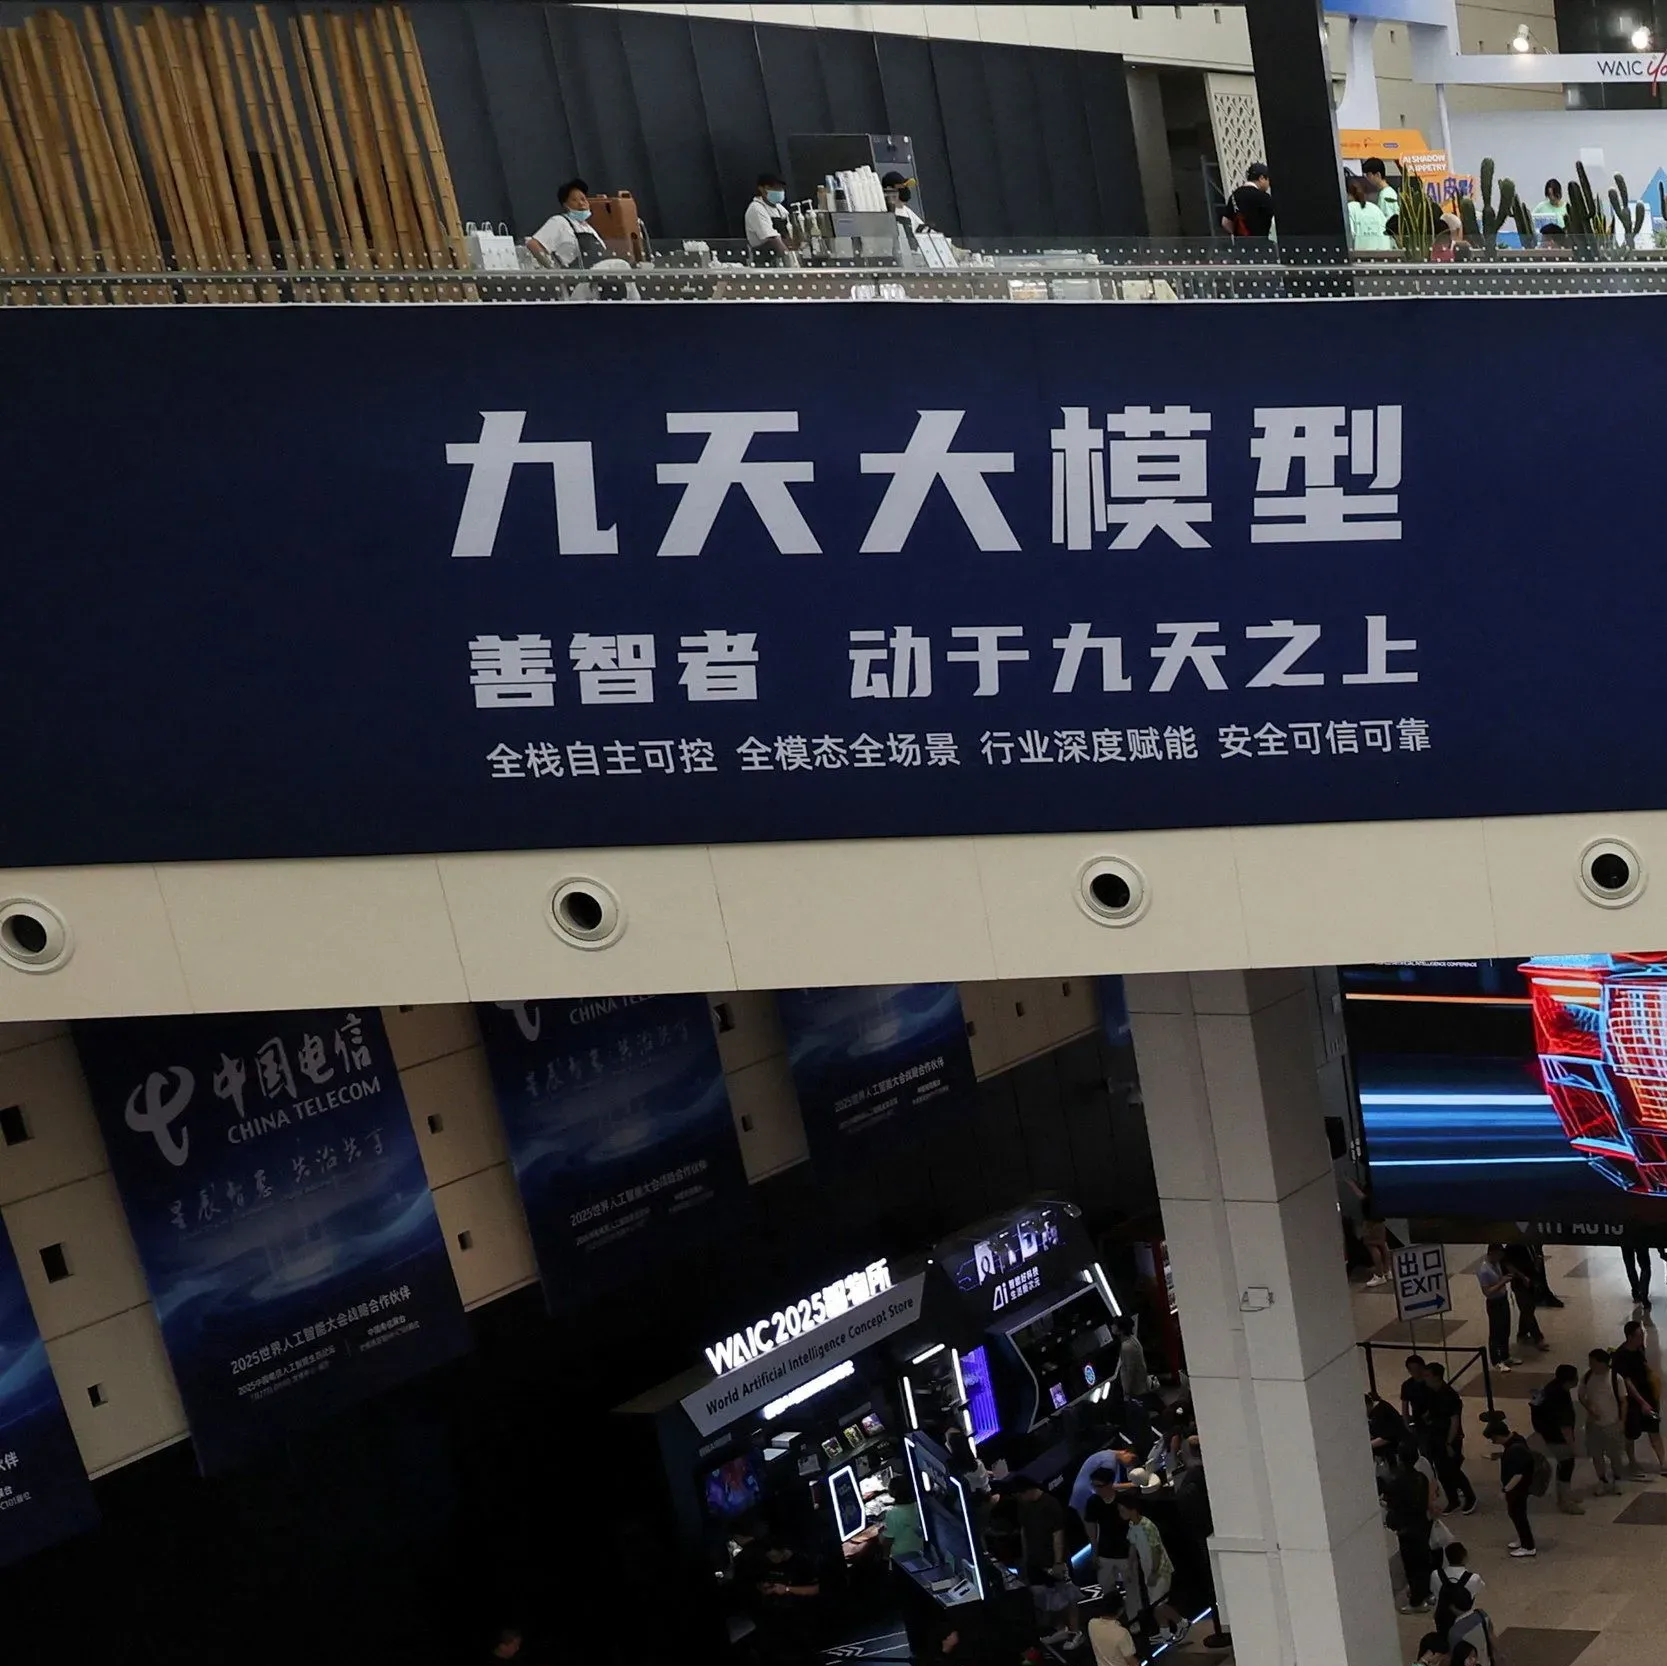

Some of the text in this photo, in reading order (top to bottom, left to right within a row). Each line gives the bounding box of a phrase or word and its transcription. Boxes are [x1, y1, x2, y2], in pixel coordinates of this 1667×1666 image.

[1597, 59, 1643, 76] WAIC
[445, 405, 1404, 558] 九天大模型
[467, 615, 1420, 708] 善智者 动于九天之上
[486, 716, 1432, 779] 全栈自主可控 全模态全场景 行业深度赋能 安全可信可靠
[212, 1012, 372, 1119] 中国电信
[227, 1076, 381, 1145] CHINA TELECOM
[1398, 1251, 1440, 1278] 出口
[1401, 1274, 1443, 1297] EXIT
[229, 1284, 411, 1375] 2025世界人工智能大会战略合作伙伴
[706, 1391, 740, 1417] World
[742, 1363, 787, 1397] Artificial
[788, 1333, 847, 1371] Intelligence
[848, 1310, 889, 1339] Concept
[888, 1298, 915, 1320] Store
